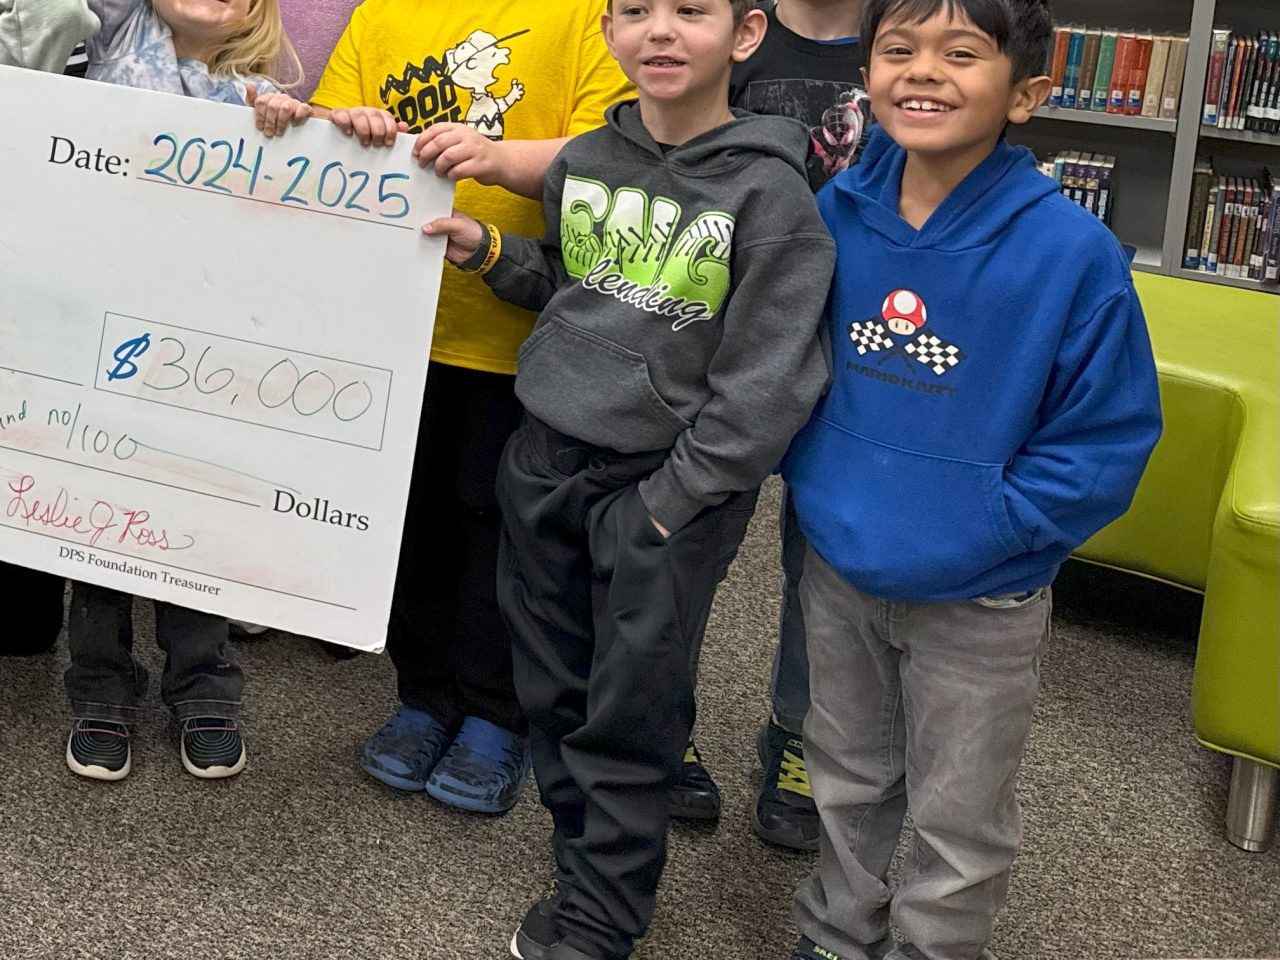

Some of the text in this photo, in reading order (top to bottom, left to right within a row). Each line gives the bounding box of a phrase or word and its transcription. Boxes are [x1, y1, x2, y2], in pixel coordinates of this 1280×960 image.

[48, 135, 131, 177] Date:
[144, 134, 410, 218] 2024-2025
[582, 256, 712, 332] lending
[106, 333, 373, 421] $36,000
[6, 474, 91, 534] Leslie
[118, 510, 196, 551] Ross
[273, 489, 370, 532] Dollars
[58, 546, 221, 597] DPS Foundation Treasurer
